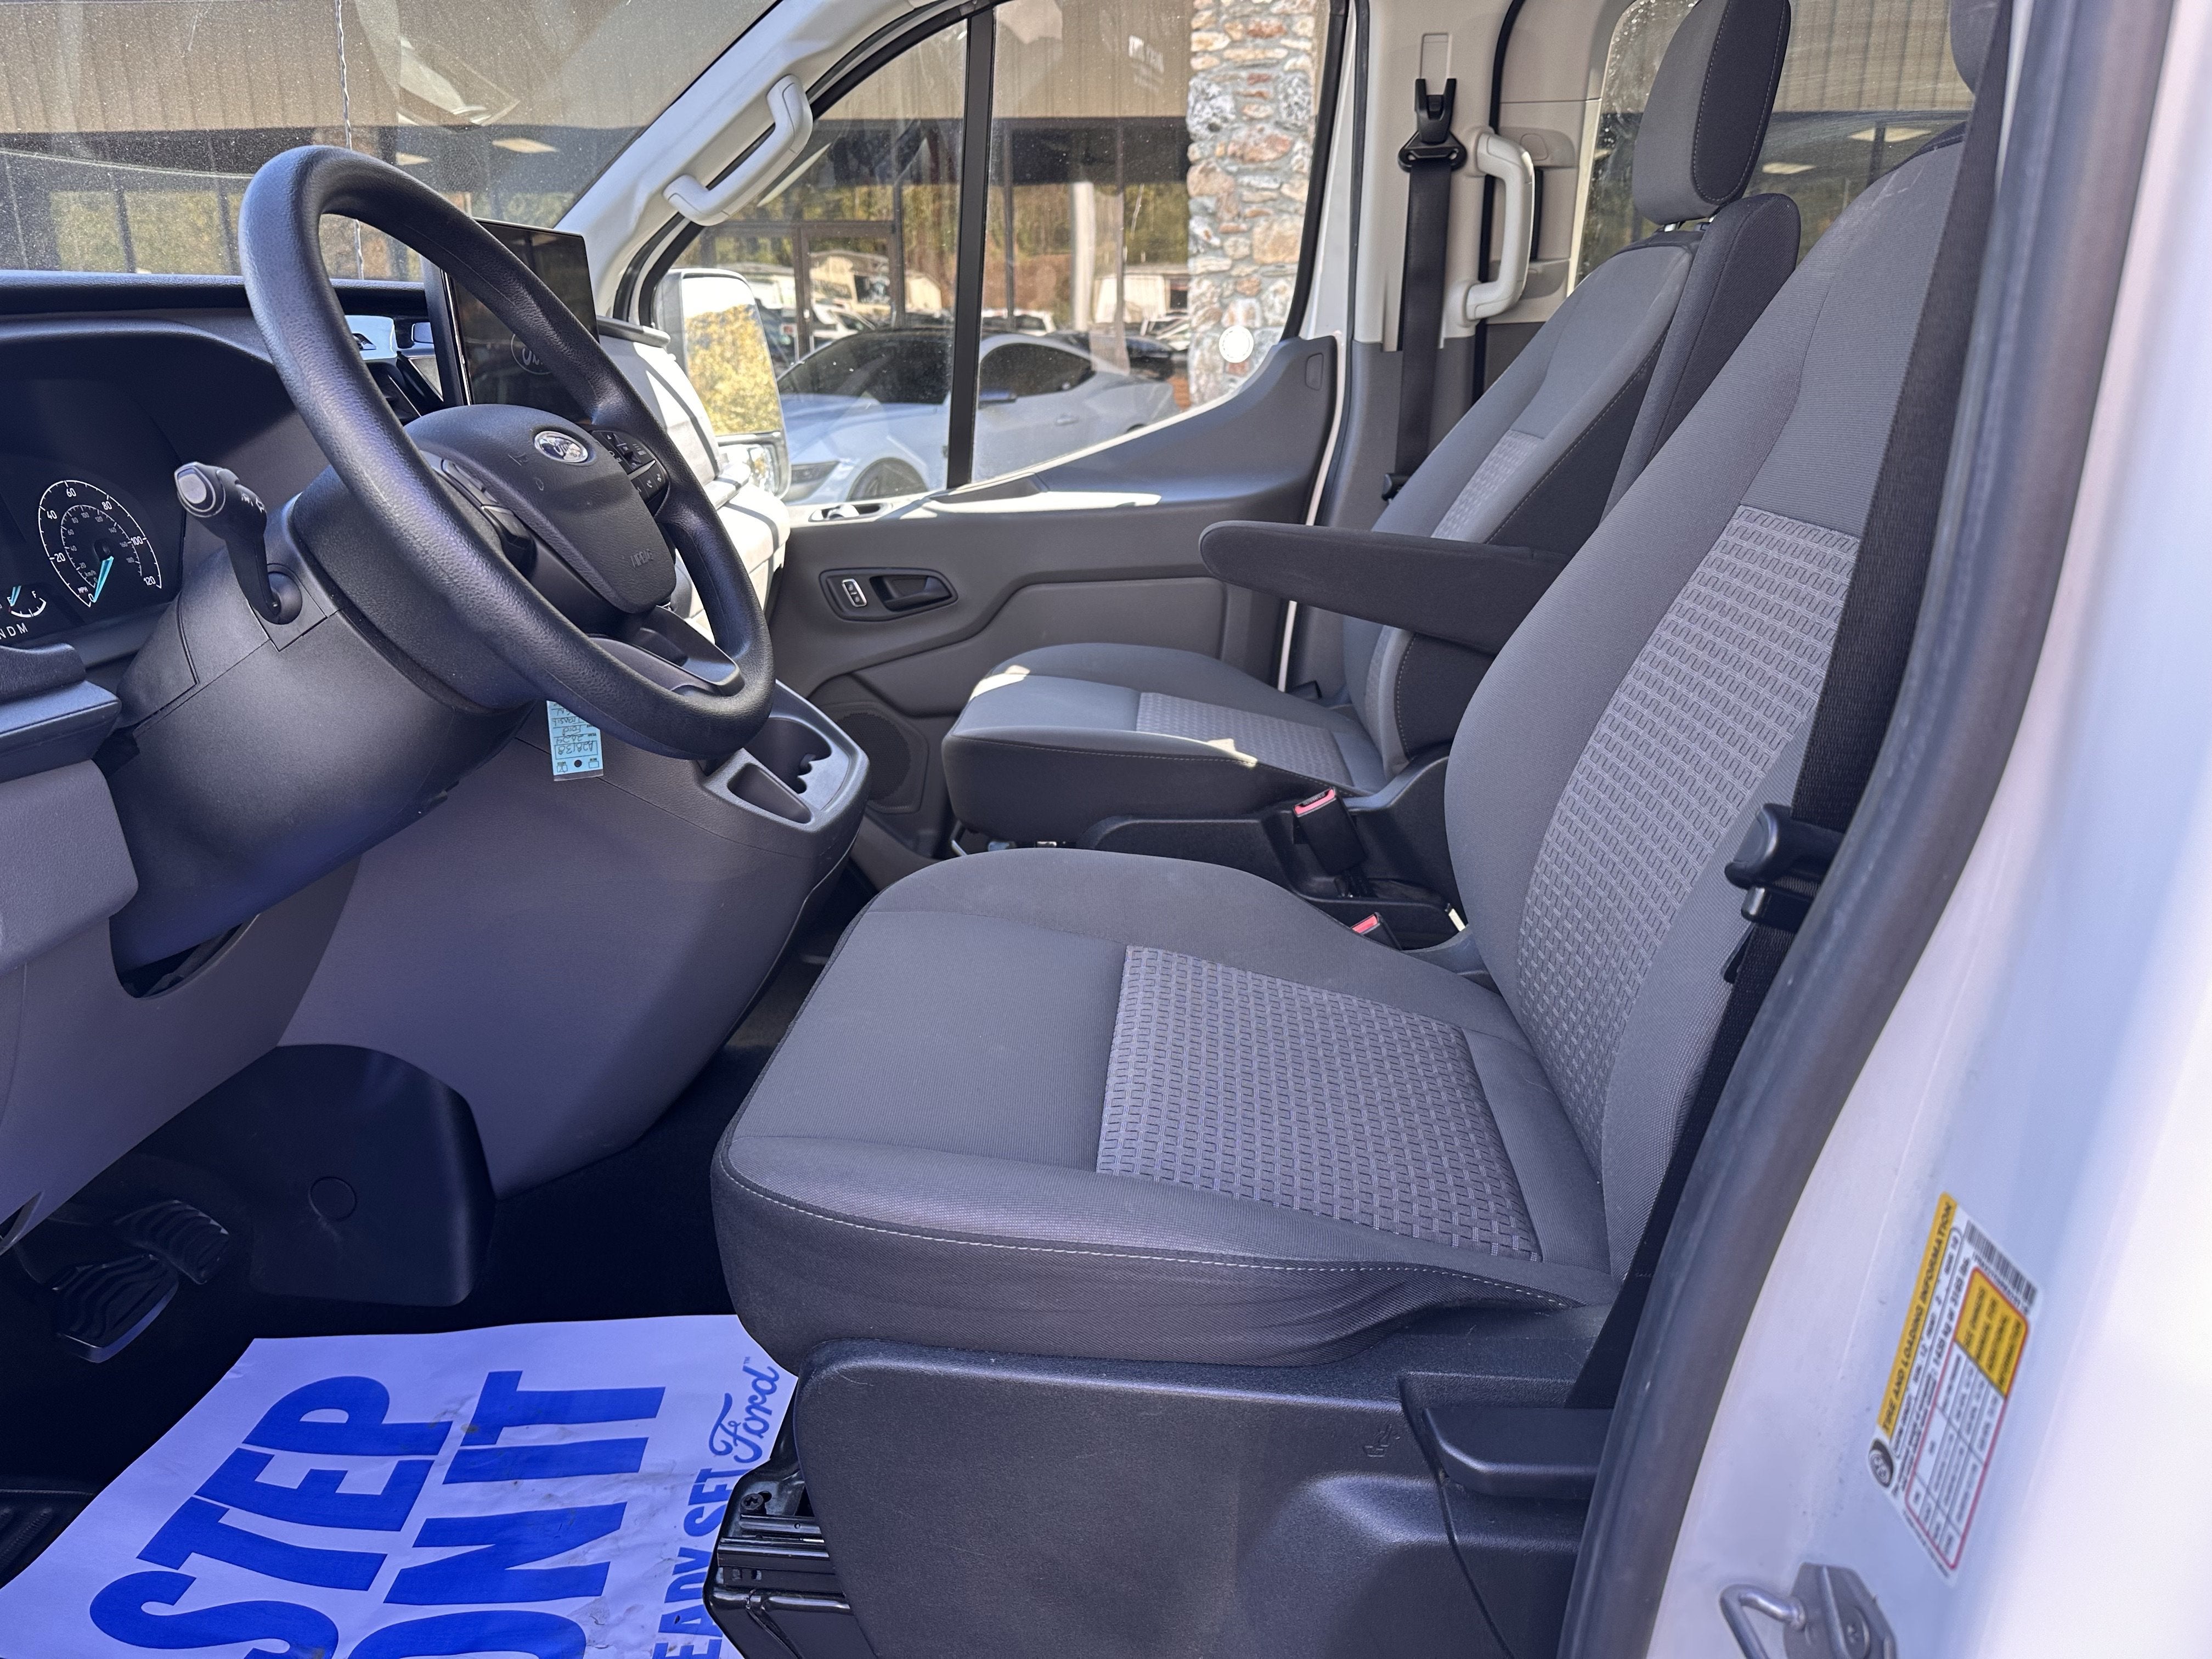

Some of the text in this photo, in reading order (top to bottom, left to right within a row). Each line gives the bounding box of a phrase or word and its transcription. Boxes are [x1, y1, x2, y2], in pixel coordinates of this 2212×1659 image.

[66, 488, 76, 497] 60
[101, 501, 112, 510] 80
[47, 510, 57, 520] 40
[131, 536, 143, 545] 100
[54, 552, 66, 562] 20
[144, 576, 156, 586] 120
[31, 590, 37, 599] F
[88, 594, 95, 602] 0
[561, 725, 582, 736] Ford
[556, 734, 584, 745] 2024
[1882, 1398, 1895, 1432] TIRE
[1893, 1369, 1905, 1398] AND
[1900, 1303, 1922, 1368] LOADING
[1920, 1202, 1951, 1304] INFORMATION
[708, 1365, 780, 1464] Ford
[90, 1376, 453, 1659] STEP
